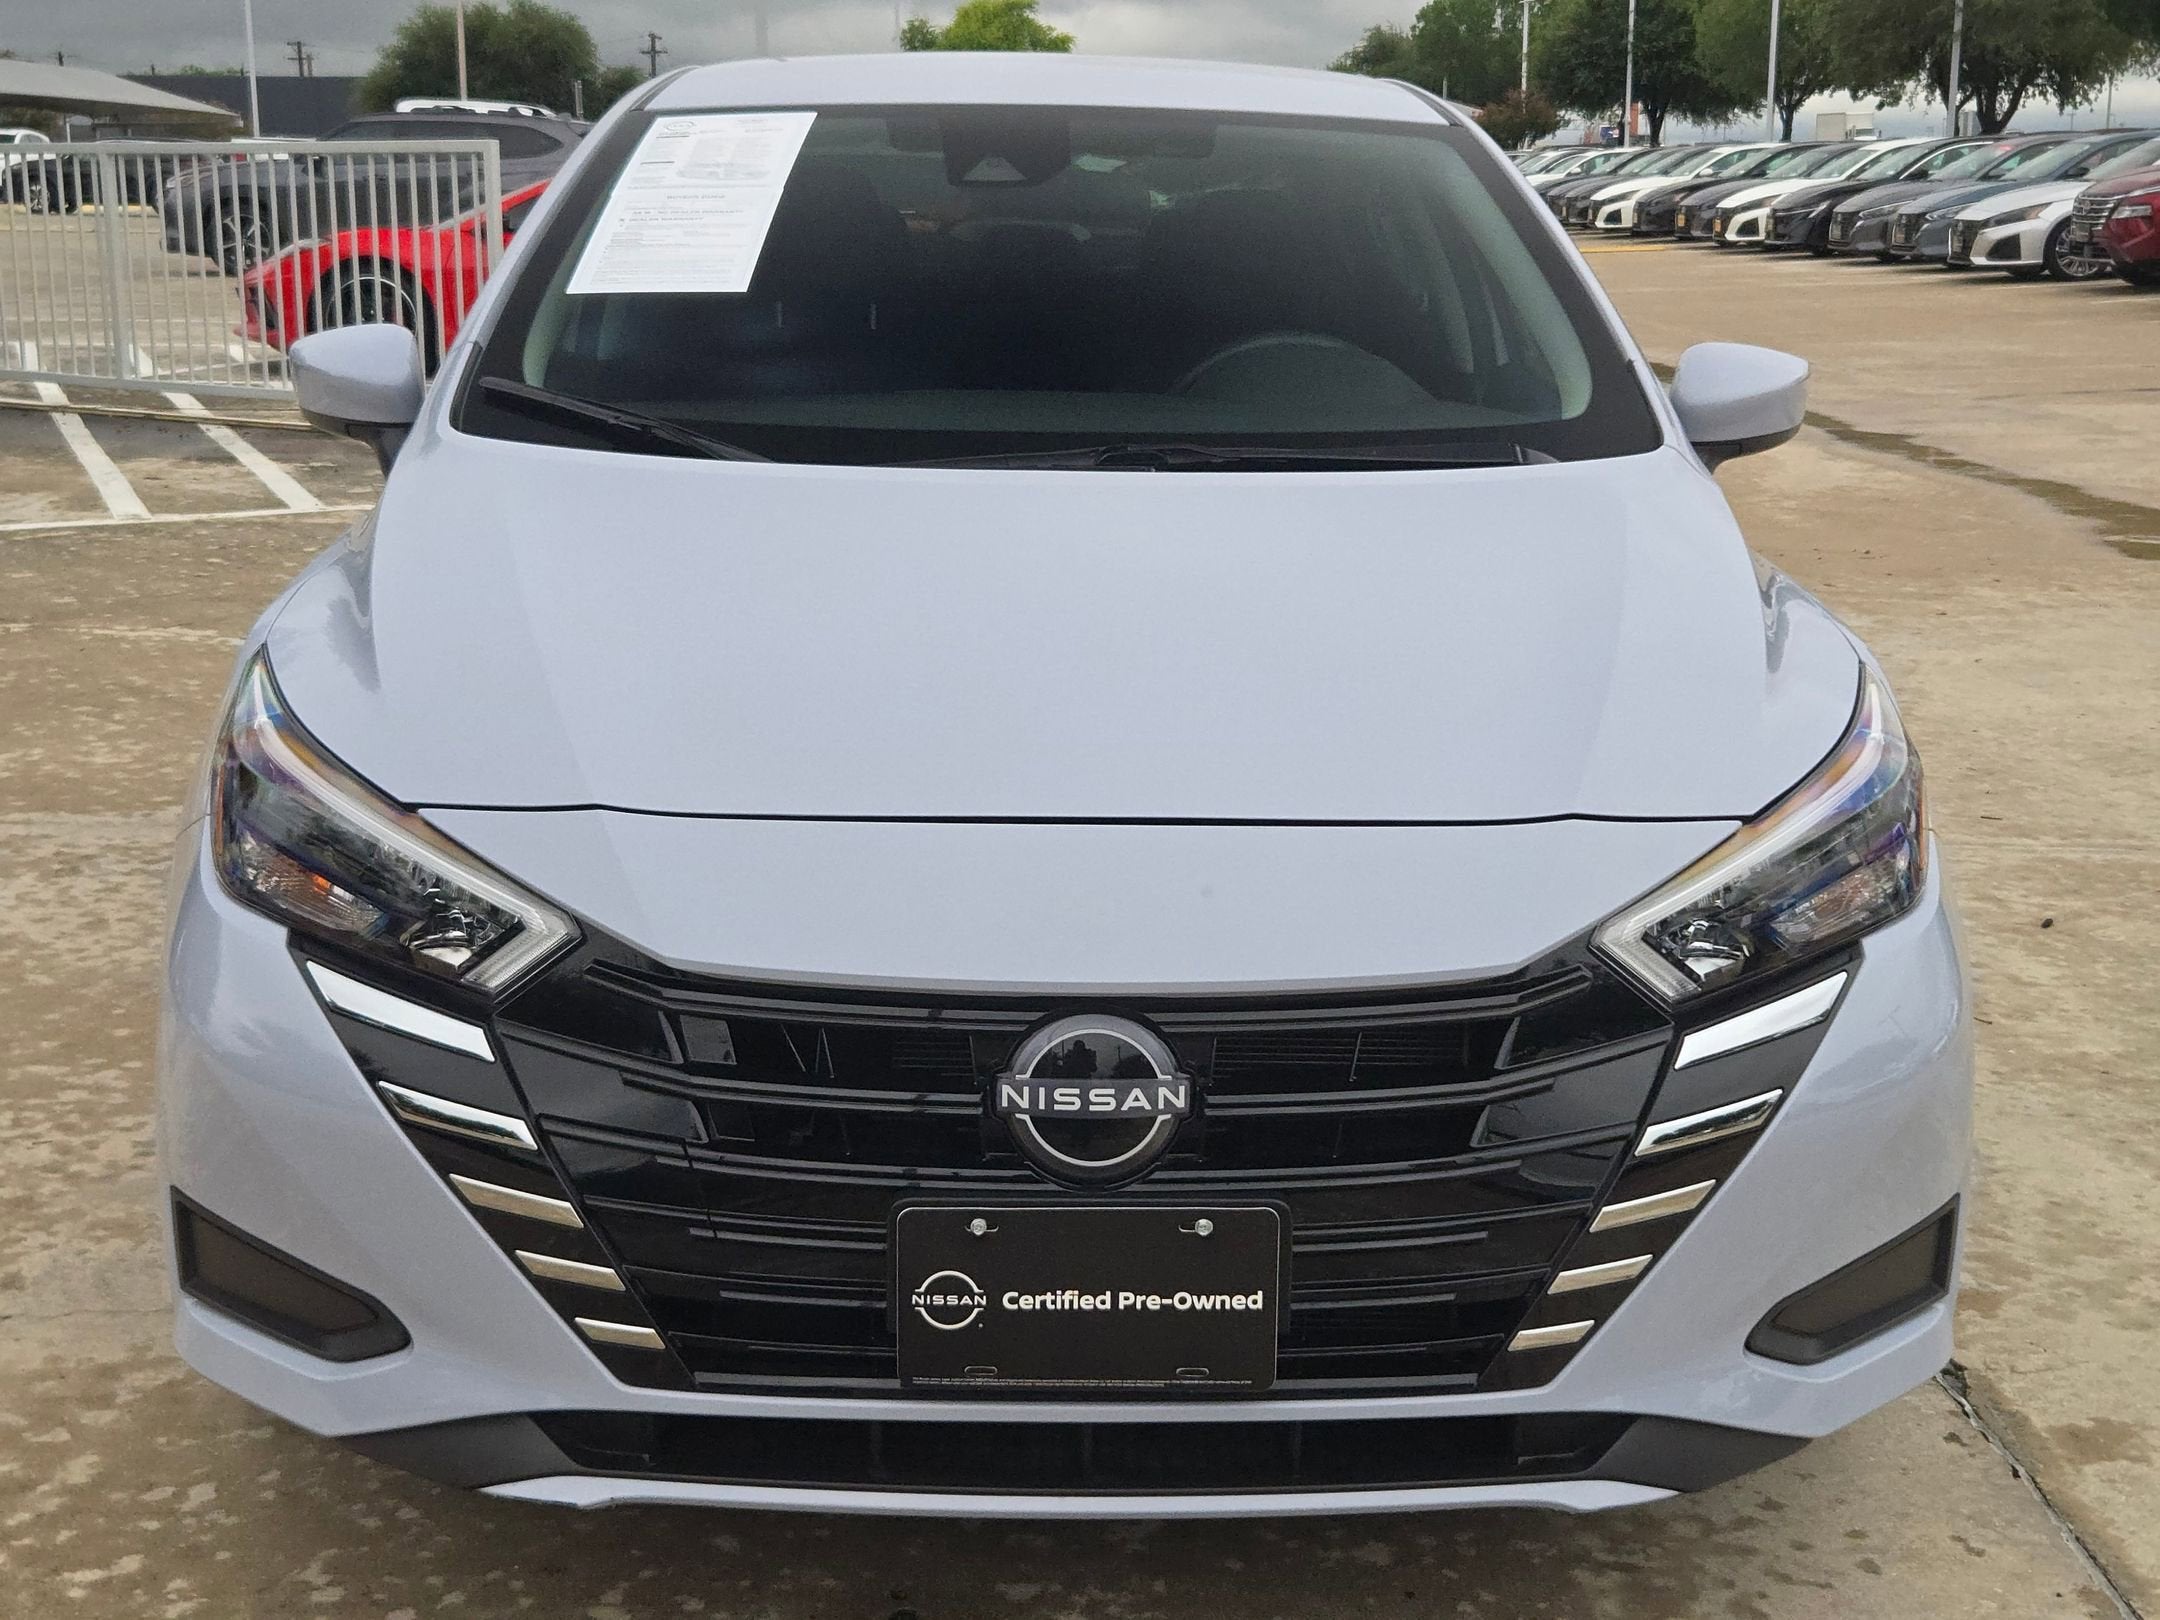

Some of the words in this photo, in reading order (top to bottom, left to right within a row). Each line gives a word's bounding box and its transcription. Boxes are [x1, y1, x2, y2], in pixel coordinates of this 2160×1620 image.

[1001, 1084, 1186, 1112] NISSAN
[911, 1294, 987, 1306] NISSAN
[1002, 1289, 1112, 1311] Certified
[1118, 1290, 1264, 1311] Pre-Owned
